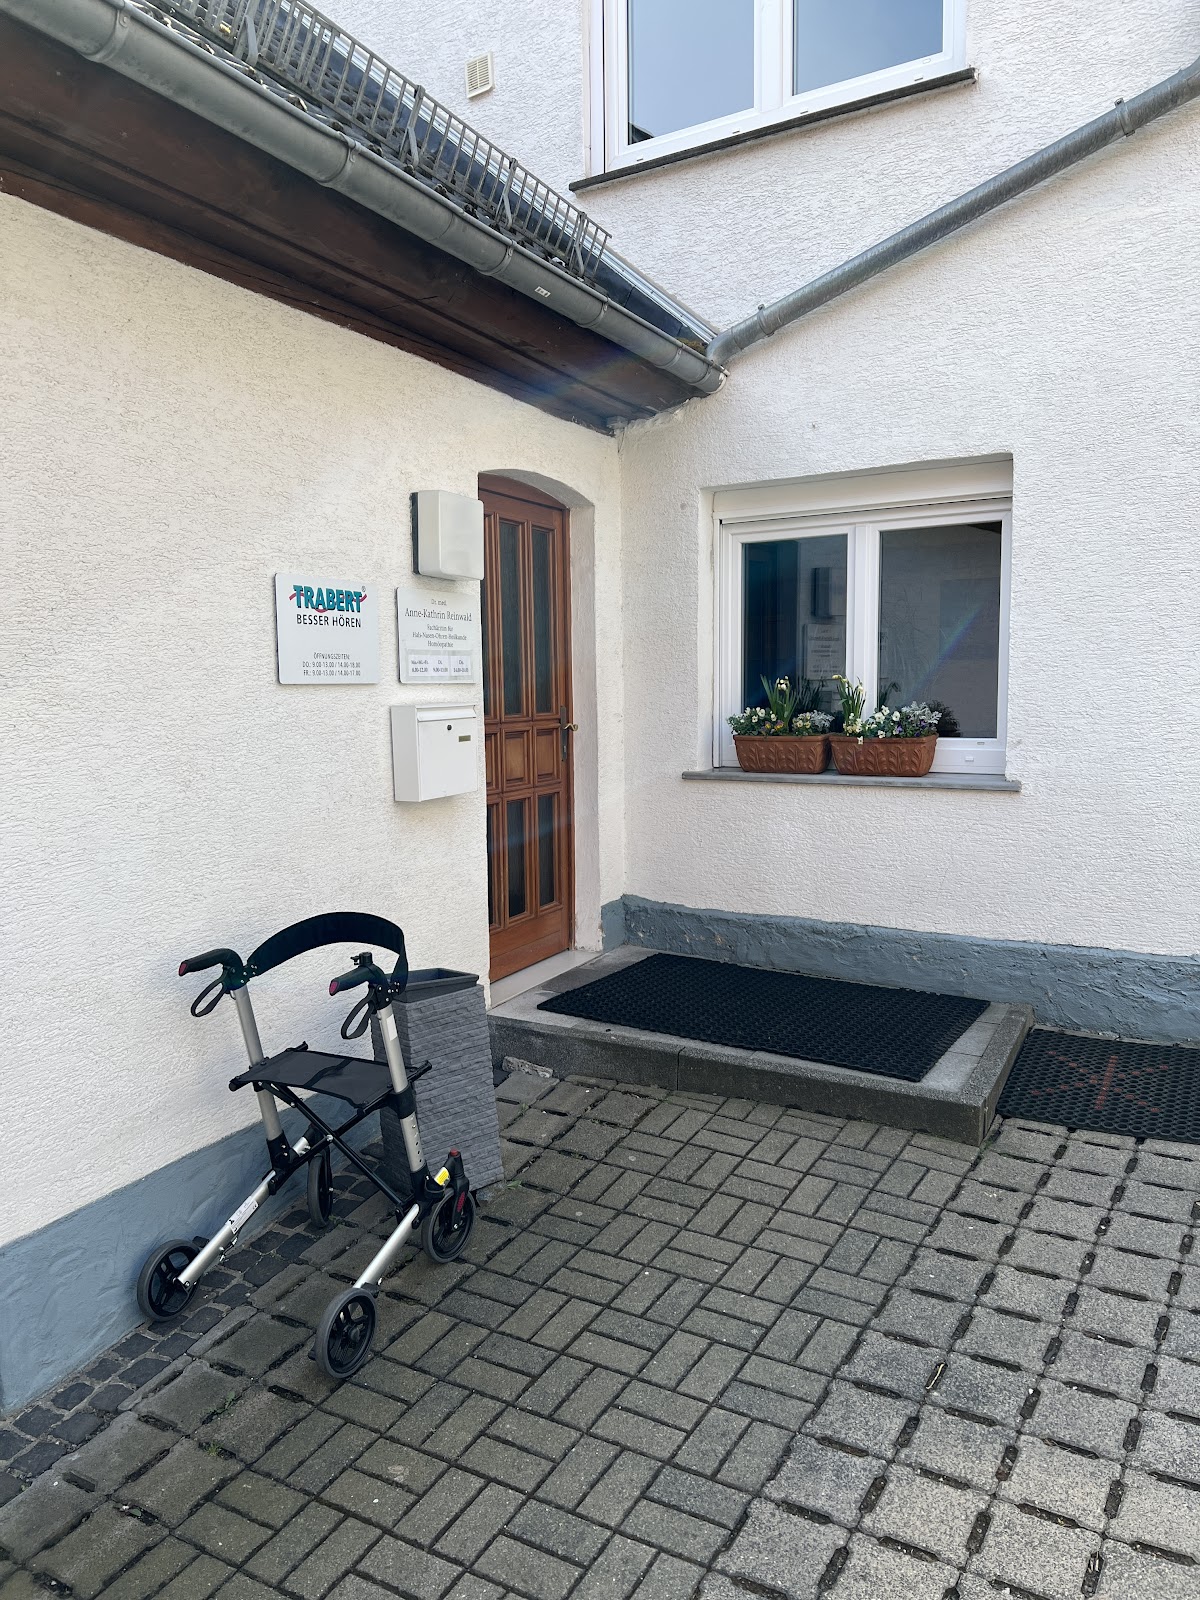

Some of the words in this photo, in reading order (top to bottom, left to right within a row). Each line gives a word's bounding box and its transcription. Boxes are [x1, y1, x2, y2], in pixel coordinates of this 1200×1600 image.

[292, 584, 363, 613] TRABERT
[296, 613, 329, 626] BESSER
[332, 615, 361, 628] HÖREN
[404, 608, 446, 620] Anne-Kathrin
[446, 611, 472, 622] Reinwald
